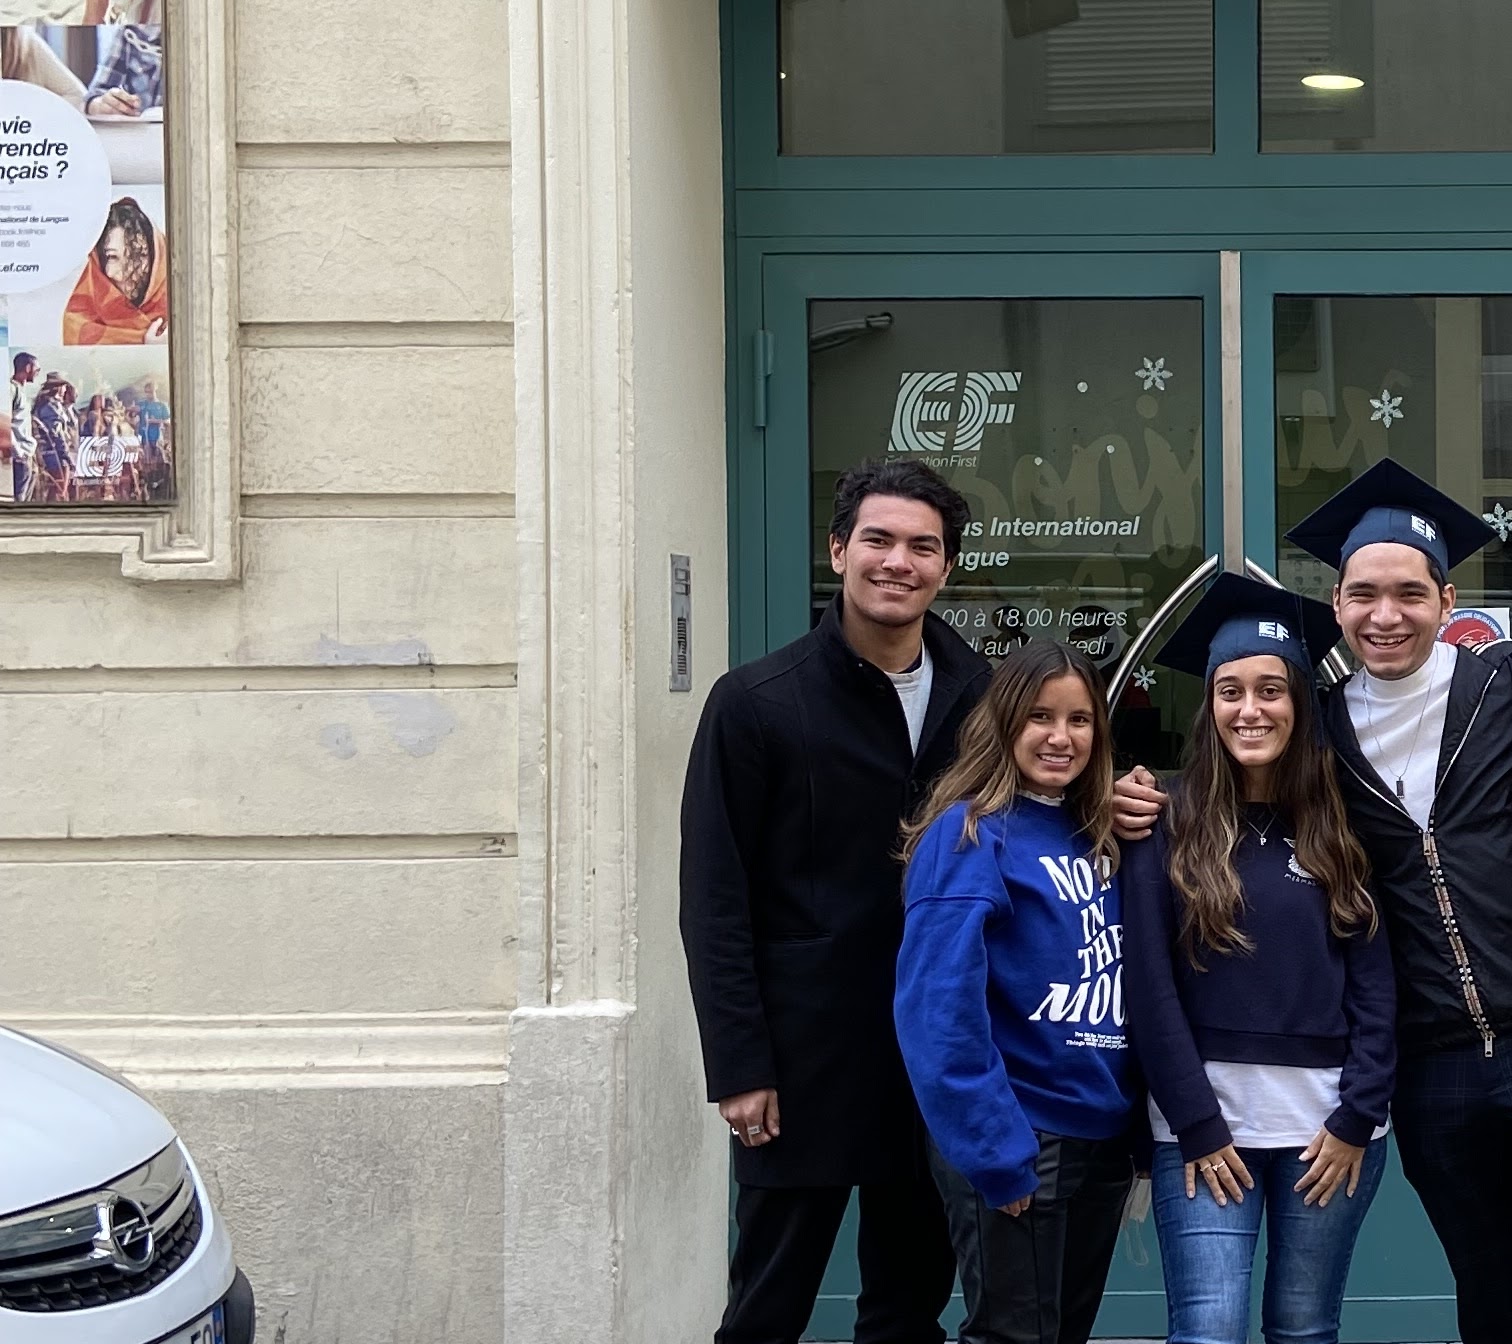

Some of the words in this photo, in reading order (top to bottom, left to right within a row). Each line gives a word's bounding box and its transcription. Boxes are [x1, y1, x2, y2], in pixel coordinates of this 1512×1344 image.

[887, 371, 1023, 452] EF
[950, 455, 977, 468] First
[989, 516, 1141, 537] International
[973, 608, 987, 628] à
[996, 608, 1053, 627] 18.00
[1058, 608, 1128, 627] heures
[984, 640, 1012, 656] au
[1080, 896, 1106, 945] IN
